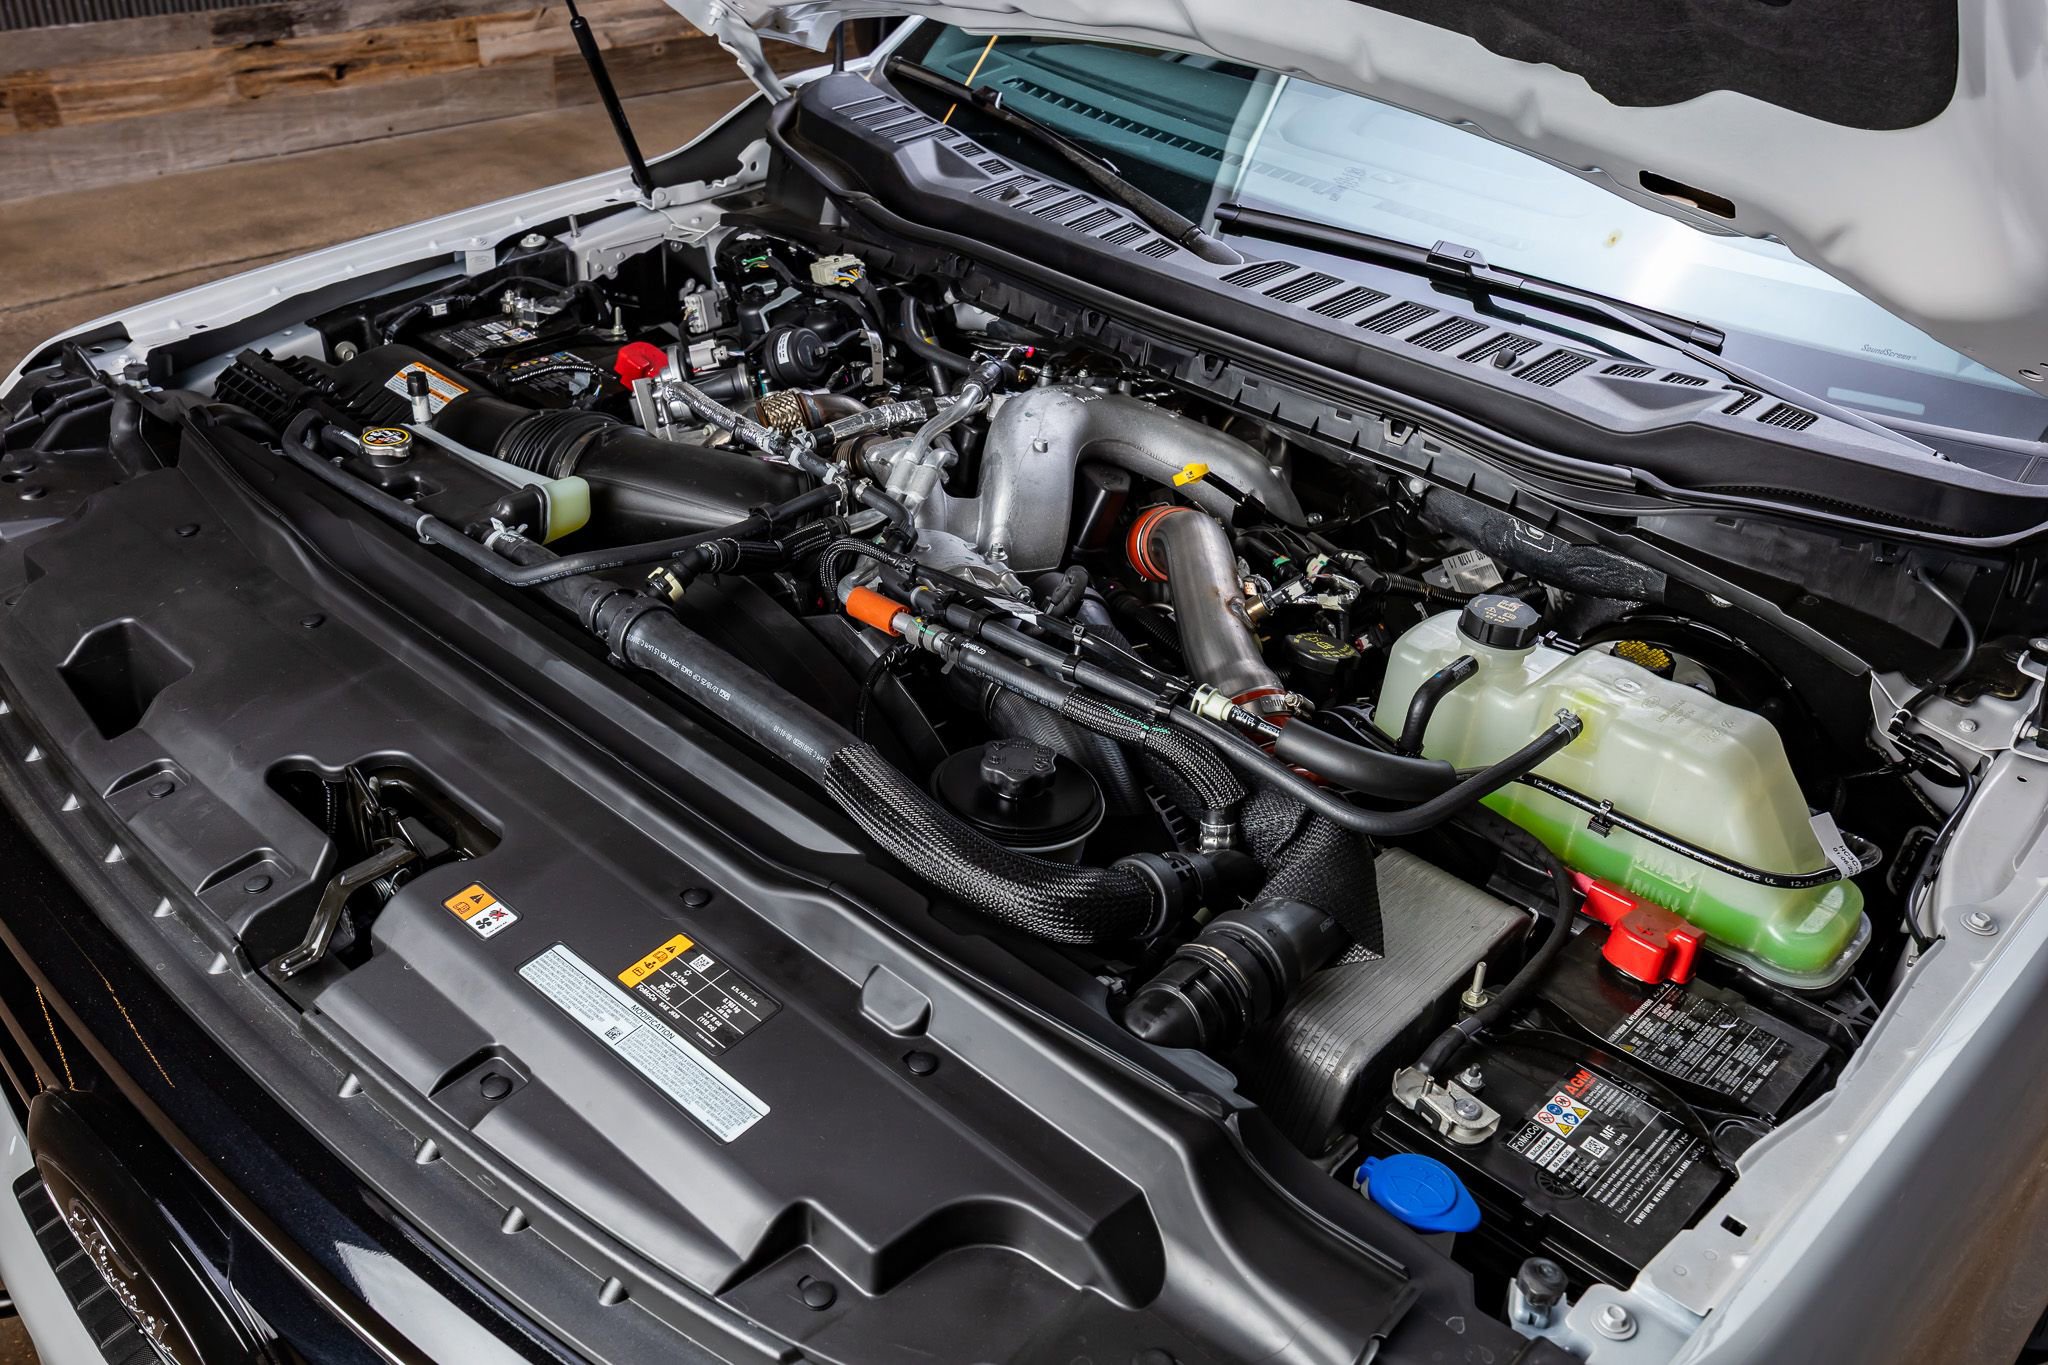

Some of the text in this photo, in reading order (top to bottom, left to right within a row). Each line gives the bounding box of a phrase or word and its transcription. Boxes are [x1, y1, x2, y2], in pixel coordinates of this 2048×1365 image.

[635, 983, 659, 1002] FoMoCo
[629, 1003, 677, 1040] MODIFICATION
[1561, 1067, 1592, 1095] AGM
[1511, 1123, 1540, 1151] FoMoCo
[1598, 1123, 1618, 1140] MF
